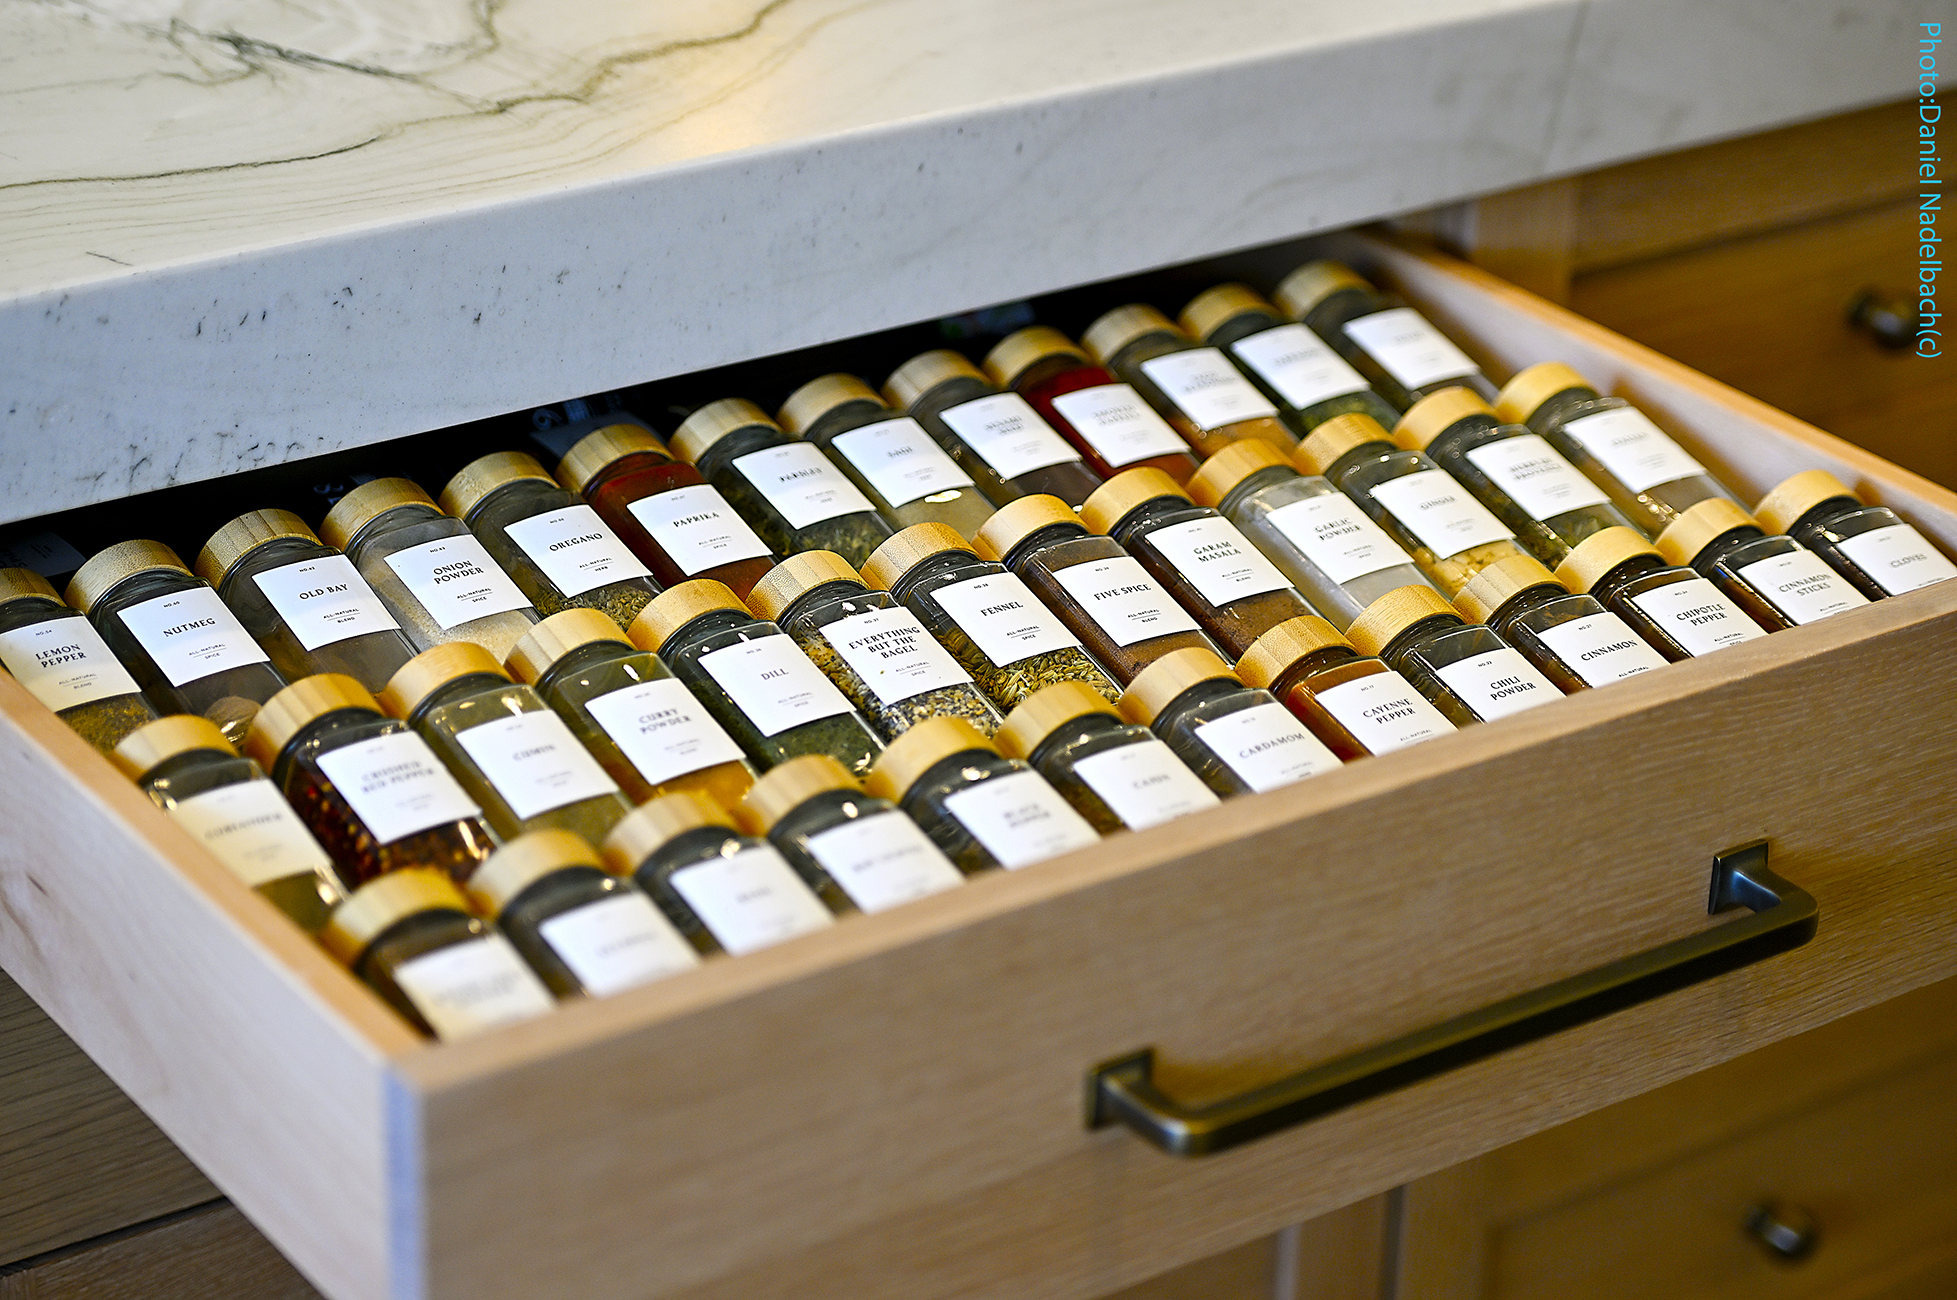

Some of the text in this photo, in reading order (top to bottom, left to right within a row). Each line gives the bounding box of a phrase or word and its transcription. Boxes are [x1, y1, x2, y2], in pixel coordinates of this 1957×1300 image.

[1420, 495, 1457, 511] GINGER
[672, 511, 720, 528] PAPRIKA
[1314, 517, 1354, 533] GARLIC
[1318, 524, 1364, 542] POWDER
[549, 532, 603, 552] OREGANO
[1193, 541, 1233, 556] GARAM
[579, 556, 613, 569] ALL-NATURAL
[1198, 548, 1242, 563] MASALA
[1889, 553, 1929, 570] CLOVES
[433, 560, 473, 576] ONION
[433, 566, 485, 585] POWDER
[1778, 572, 1832, 593] CINNAMON
[1796, 581, 1832, 598] STICKS
[299, 582, 349, 600] OLD BAY
[456, 587, 493, 600] ALL-NATURAL
[1094, 583, 1152, 602] FIVE SPICE
[323, 607, 360, 619] ALL-NATURAL
[980, 601, 1024, 617] FENNEL
[1127, 608, 1160, 619] ALL-NATURAL
[1675, 602, 1727, 622] CHIPOTLE
[337, 616, 356, 624] BLEND
[1690, 611, 1728, 627] PEPPER
[163, 617, 217, 638] NUTMEG
[1006, 624, 1040, 637] ALL-NATURAL
[848, 626, 921, 650] EVERYTHING
[867, 635, 917, 653] BUT THE
[1714, 631, 1744, 643] ALL-NATURAL
[35, 643, 82, 661] LEMON
[188, 643, 227, 656] ALL-NATURAL
[204, 652, 221, 660] SPICE
[880, 644, 918, 659] BAGEL
[1580, 638, 1639, 662] CINNAMON
[41, 652, 87, 669] PEPPER
[895, 660, 930, 673] ALL-NATURAL
[58, 672, 97, 686] ALL-NATURAL
[760, 668, 790, 681] DILL
[1618, 665, 1650, 678] ALL-NATURAL
[1490, 675, 1522, 691] CHILI
[777, 691, 813, 704] ALL-NATURAL
[1490, 682, 1537, 701] POWDER
[638, 707, 680, 725] CURRY
[1362, 698, 1414, 719] CAYENNE
[1375, 706, 1417, 725] PEPPER
[640, 715, 692, 735] POWDER
[1400, 728, 1433, 742] ALL-NATURAL
[1238, 732, 1306, 760] CARDAMOM
